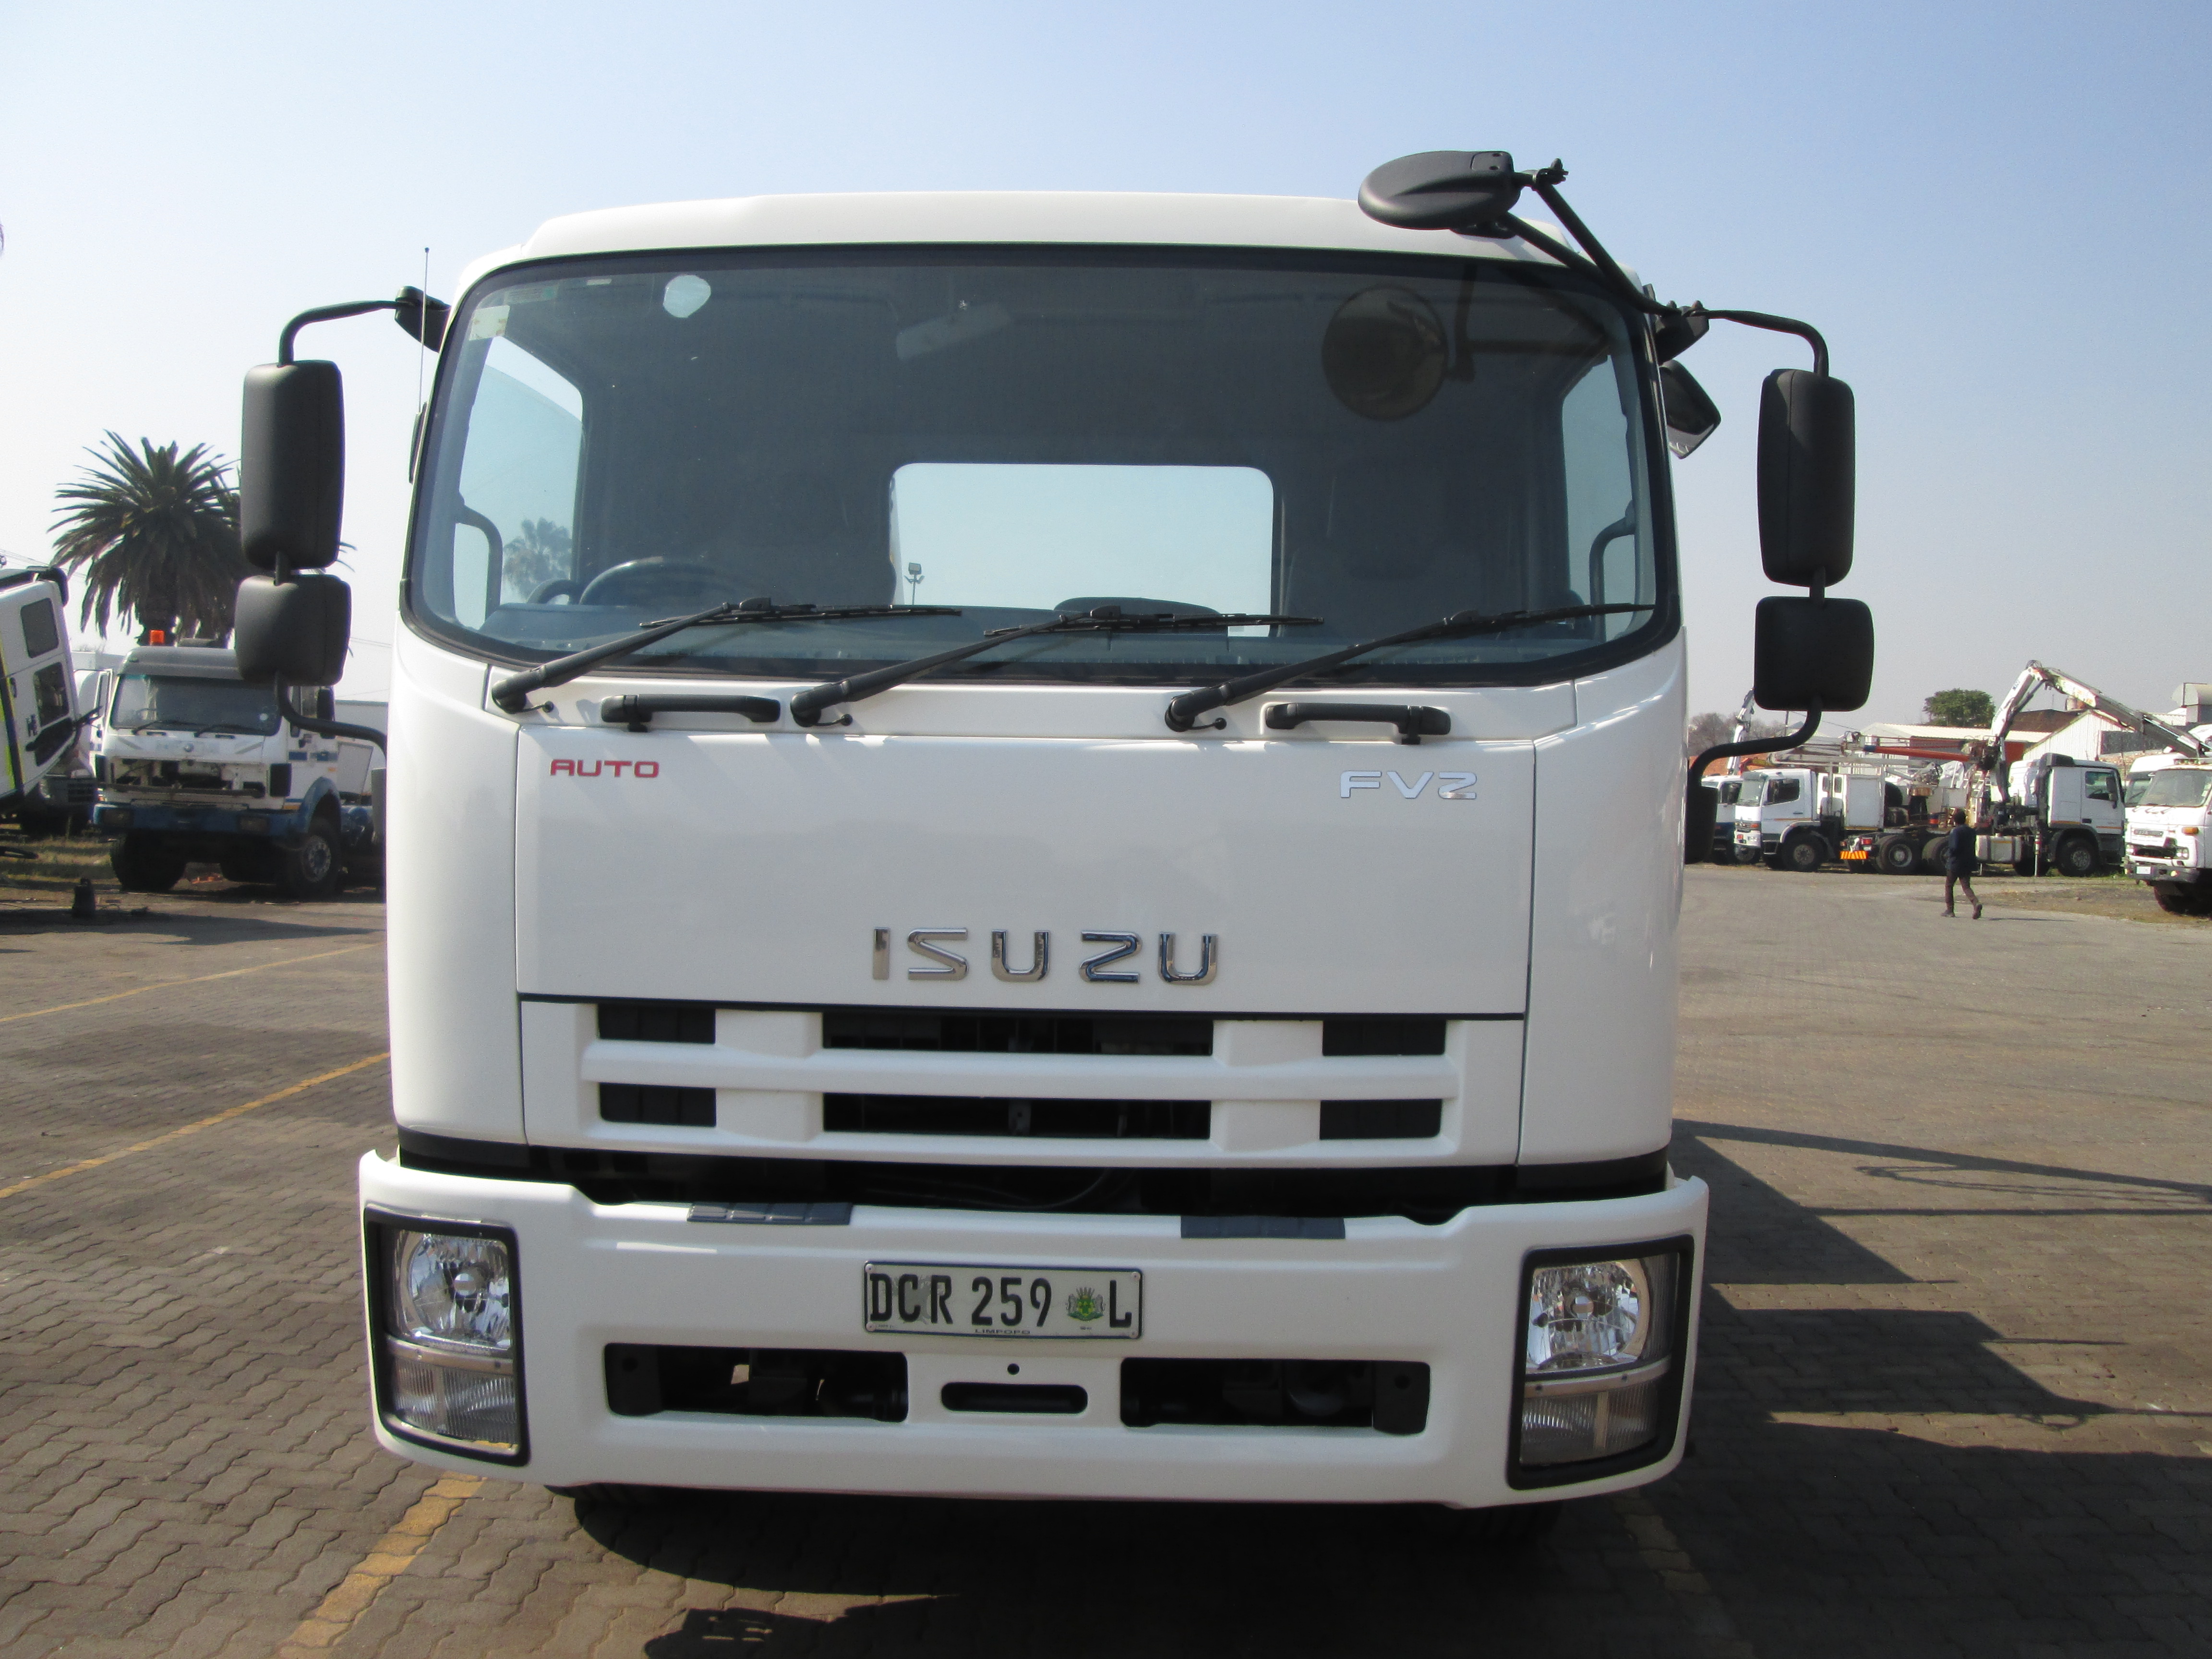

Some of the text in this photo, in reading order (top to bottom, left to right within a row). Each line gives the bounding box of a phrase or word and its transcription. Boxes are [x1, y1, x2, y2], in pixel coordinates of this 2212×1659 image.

[550, 759, 659, 778] AUTO
[1340, 770, 1477, 799] FVZ
[873, 927, 1219, 986] ISUZU
[869, 1273, 1132, 1328] DCR 259 L
